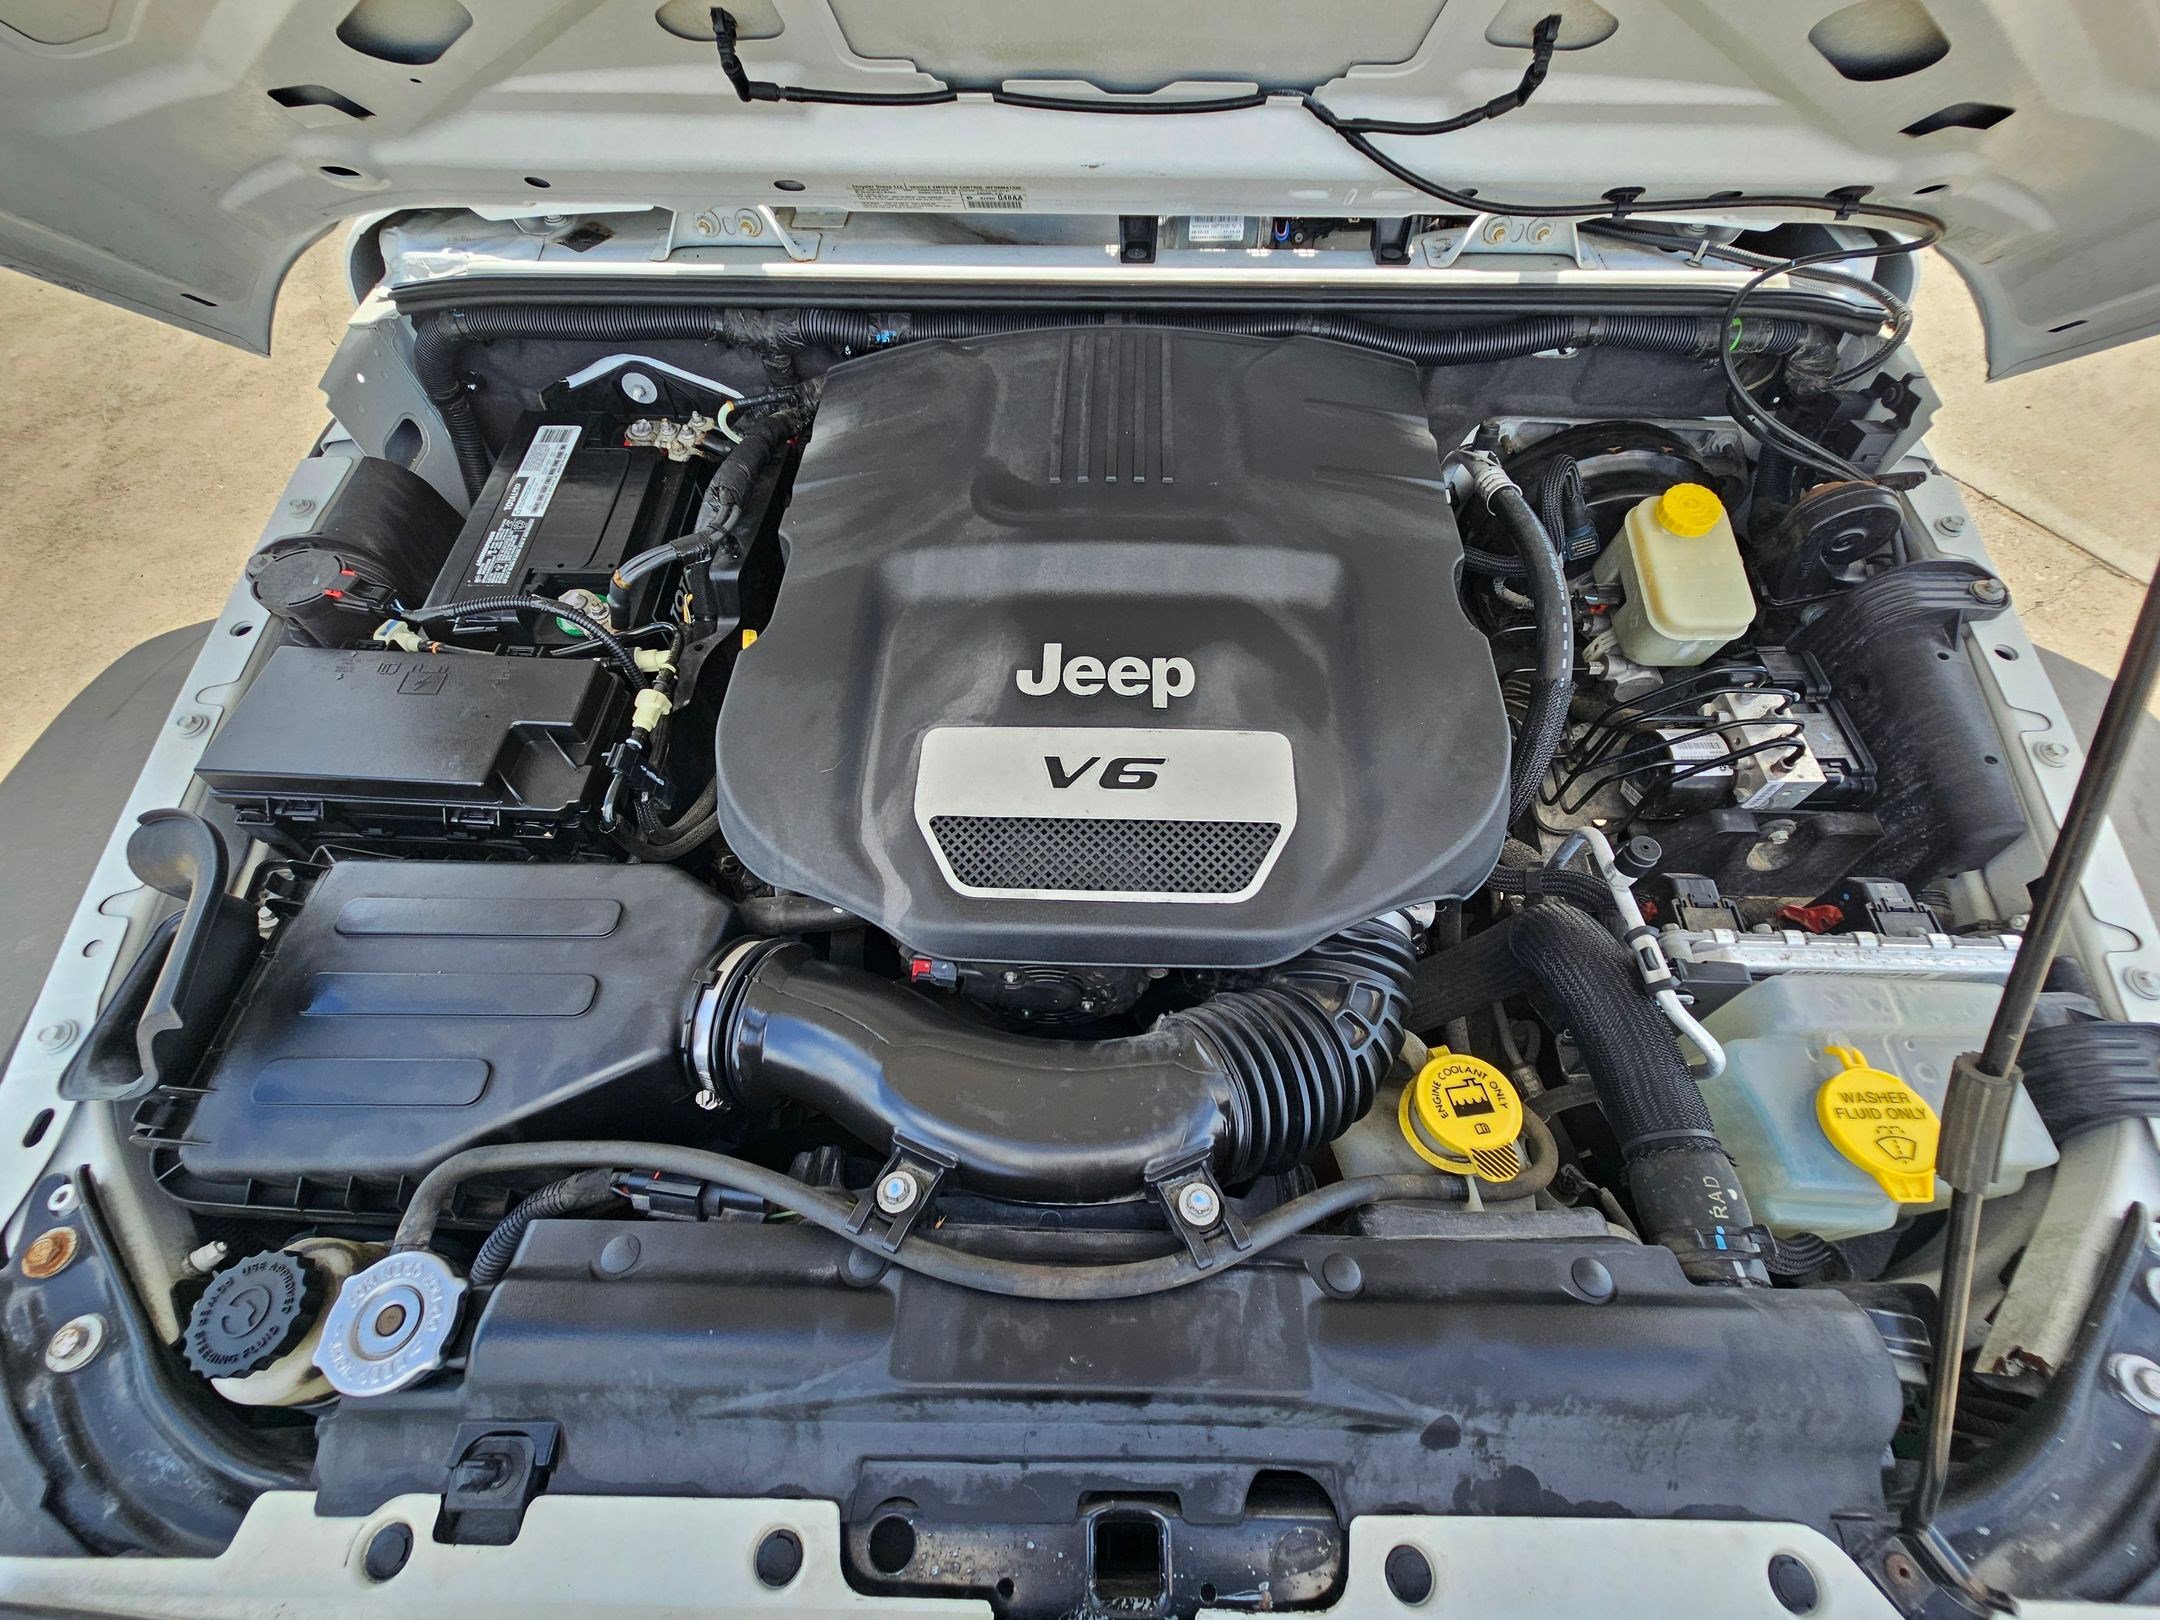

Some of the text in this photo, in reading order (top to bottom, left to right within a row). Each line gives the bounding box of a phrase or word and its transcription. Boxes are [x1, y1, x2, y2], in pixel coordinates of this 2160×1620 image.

[1016, 642, 1196, 709] Jeep
[1044, 756, 1167, 790] V6
[1431, 1065, 1509, 1119] ENGINE COOLANT ONLY
[1838, 1091, 1911, 1104] WASHER
[1834, 1107, 1927, 1121] FLUID ONLY
[269, 1261, 297, 1314] APPROVED
[193, 1330, 241, 1366] STEERING
